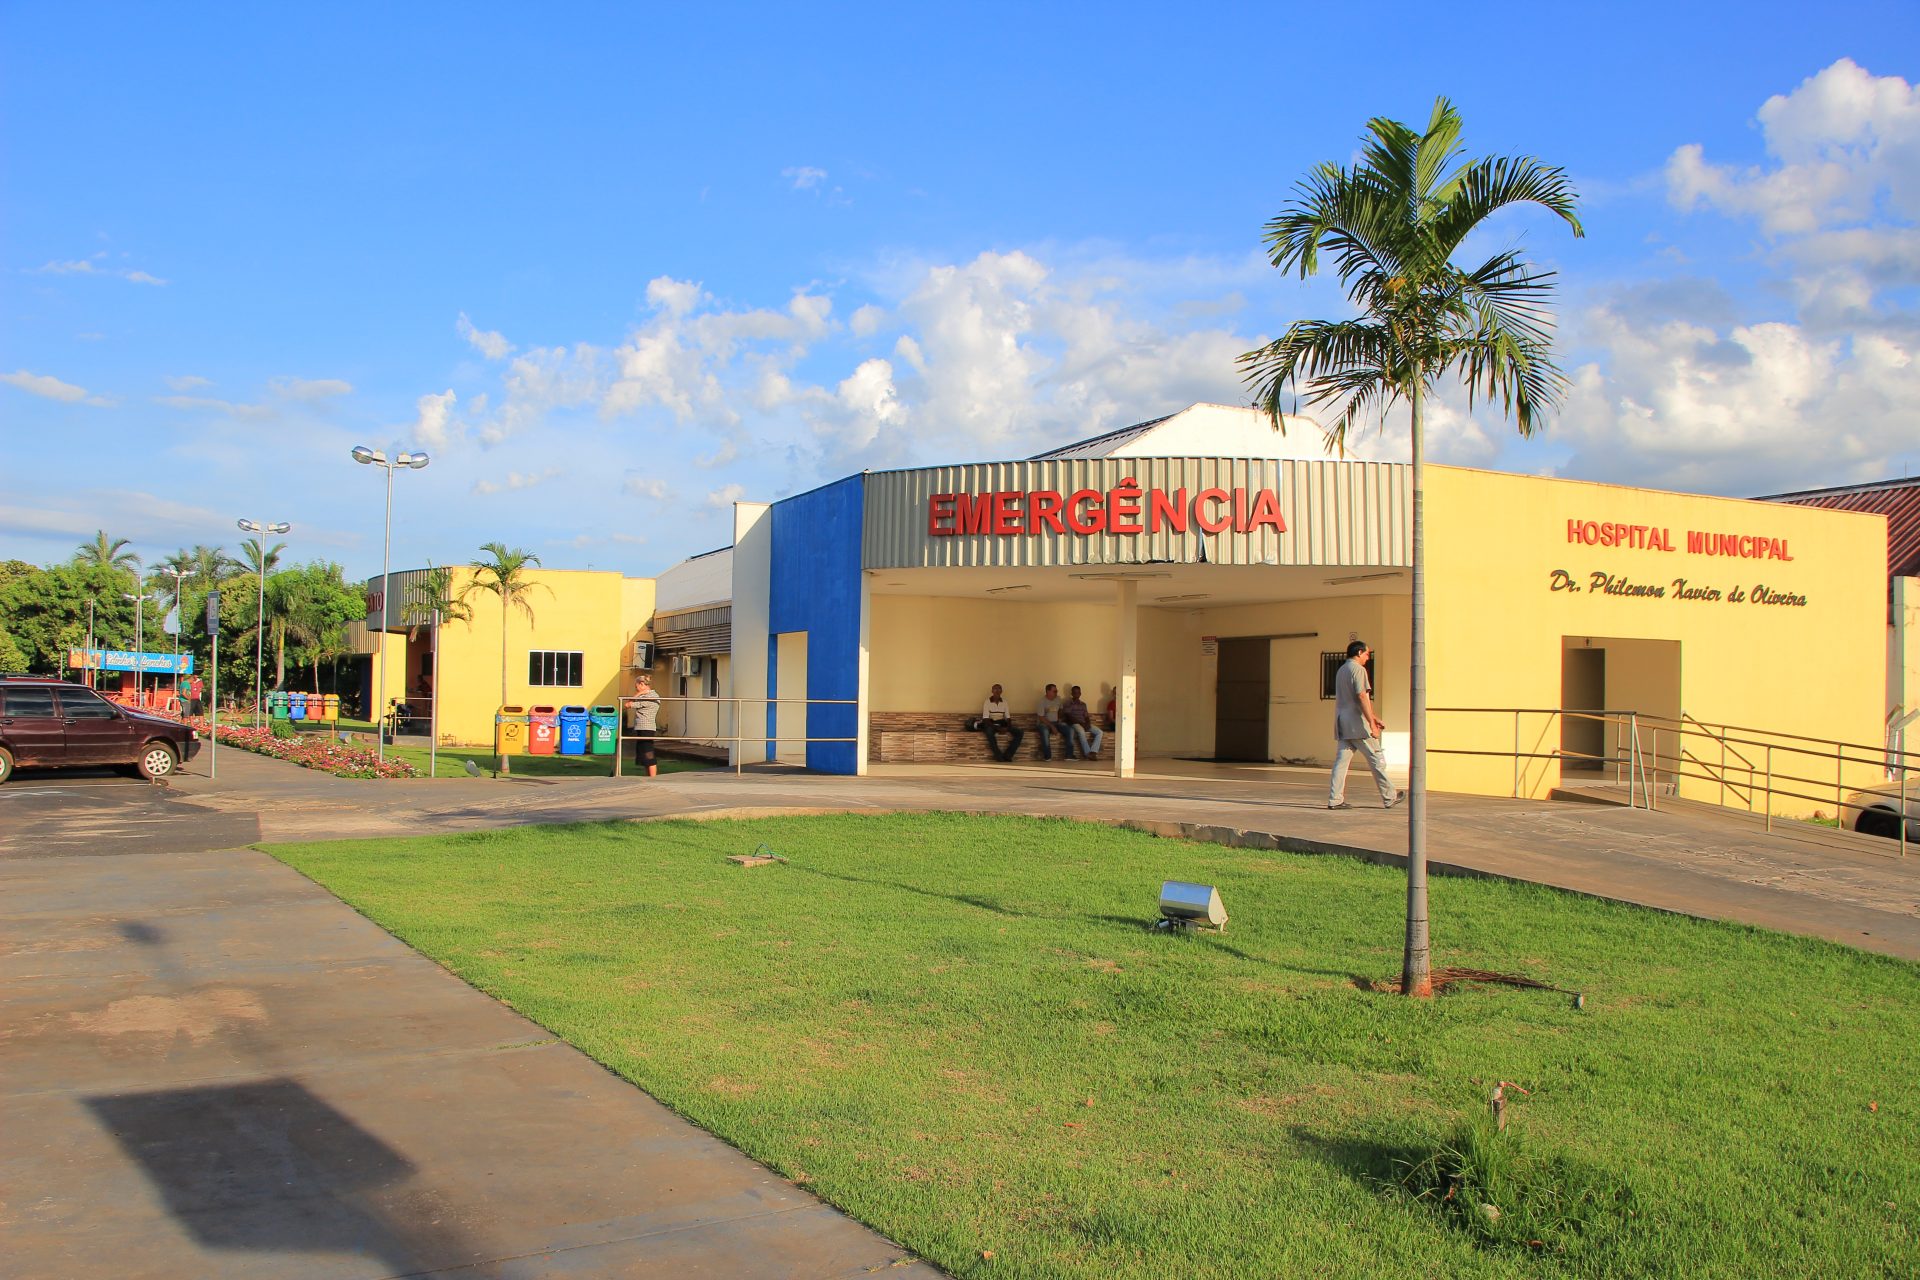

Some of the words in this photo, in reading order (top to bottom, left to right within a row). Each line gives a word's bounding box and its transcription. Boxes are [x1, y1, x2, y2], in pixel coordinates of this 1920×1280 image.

[928, 477, 1288, 536] EMERGÊNCIA
[1567, 519, 1676, 552] HOSPITAL
[1687, 530, 1794, 562] MUNICIPAL
[1550, 569, 1581, 592] Dr.
[1589, 571, 1665, 599] Philemon
[1671, 578, 1722, 601] Xavier
[1727, 585, 1745, 603] de
[1750, 584, 1807, 607] Oliveira
